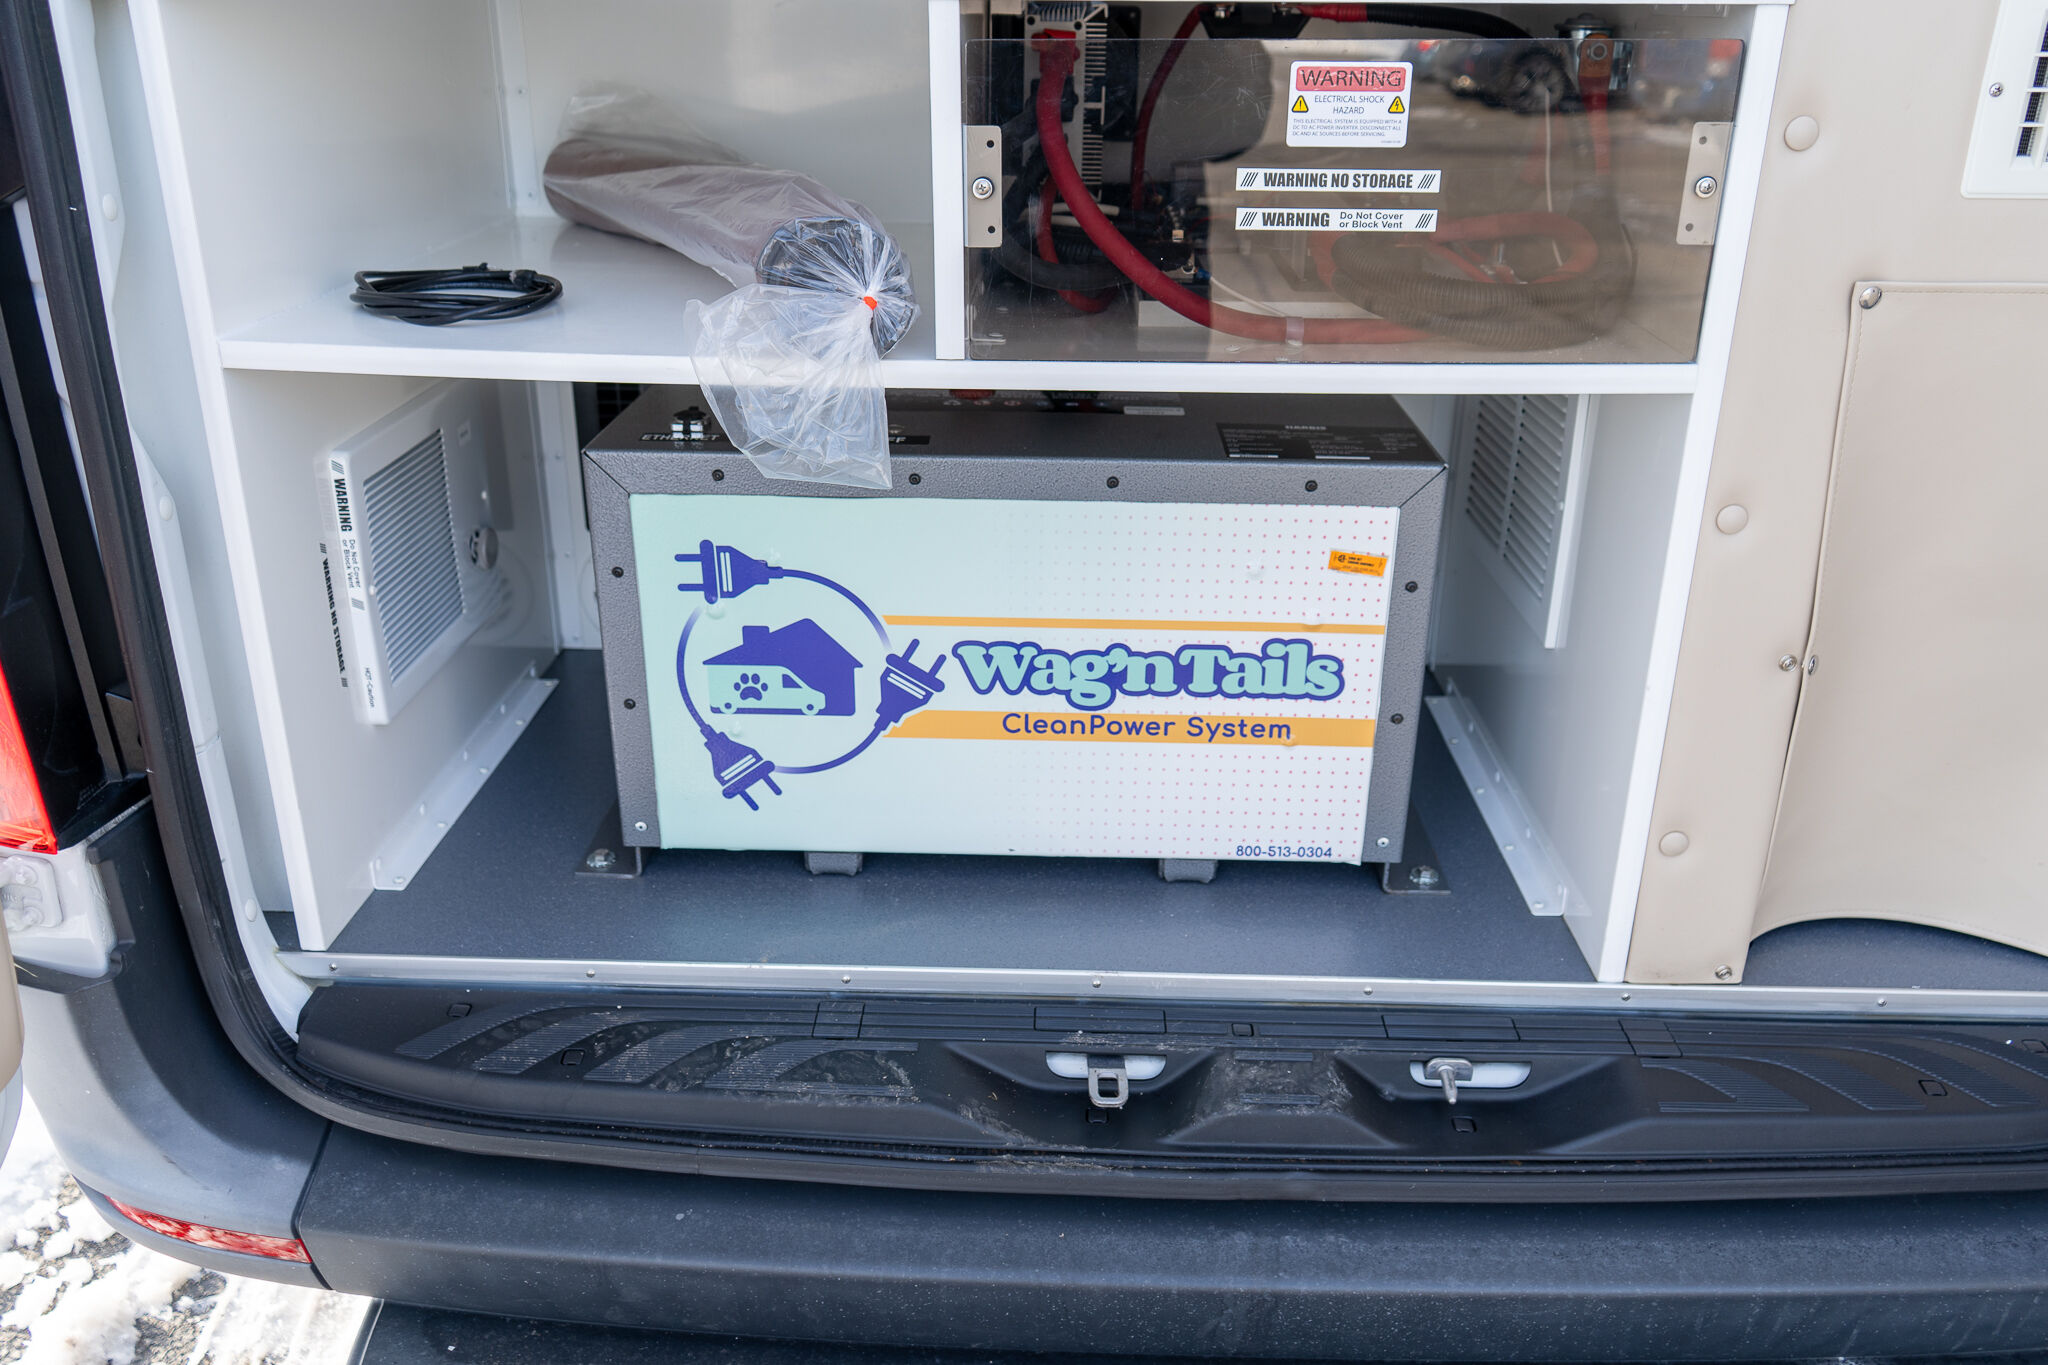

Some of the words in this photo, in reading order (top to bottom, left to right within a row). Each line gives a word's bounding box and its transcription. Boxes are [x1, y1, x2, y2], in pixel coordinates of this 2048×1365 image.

[1301, 70, 1402, 87] WARNING
[1314, 95, 1357, 103] ELECTRICAL
[1359, 96, 1385, 104] SHOCK
[1332, 106, 1365, 115] HAZARD
[1263, 172, 1328, 188] WARNING
[1330, 173, 1350, 188] NO
[1352, 173, 1414, 189] STORAGE
[1261, 212, 1331, 227] WARNING
[1339, 212, 1353, 220] Do
[1356, 212, 1373, 220] Not
[1375, 212, 1404, 220] Cover
[1351, 220, 1379, 228] Block
[1381, 221, 1403, 229] Vent
[333, 478, 353, 532] WARNING
[323, 558, 335, 610] WARNING
[331, 610, 338, 626] NO
[333, 626, 346, 674] STORAGE
[1001, 712, 1177, 737] CleanPower
[1186, 715, 1293, 743] System
[1235, 845, 1333, 858] 800-513-0304
